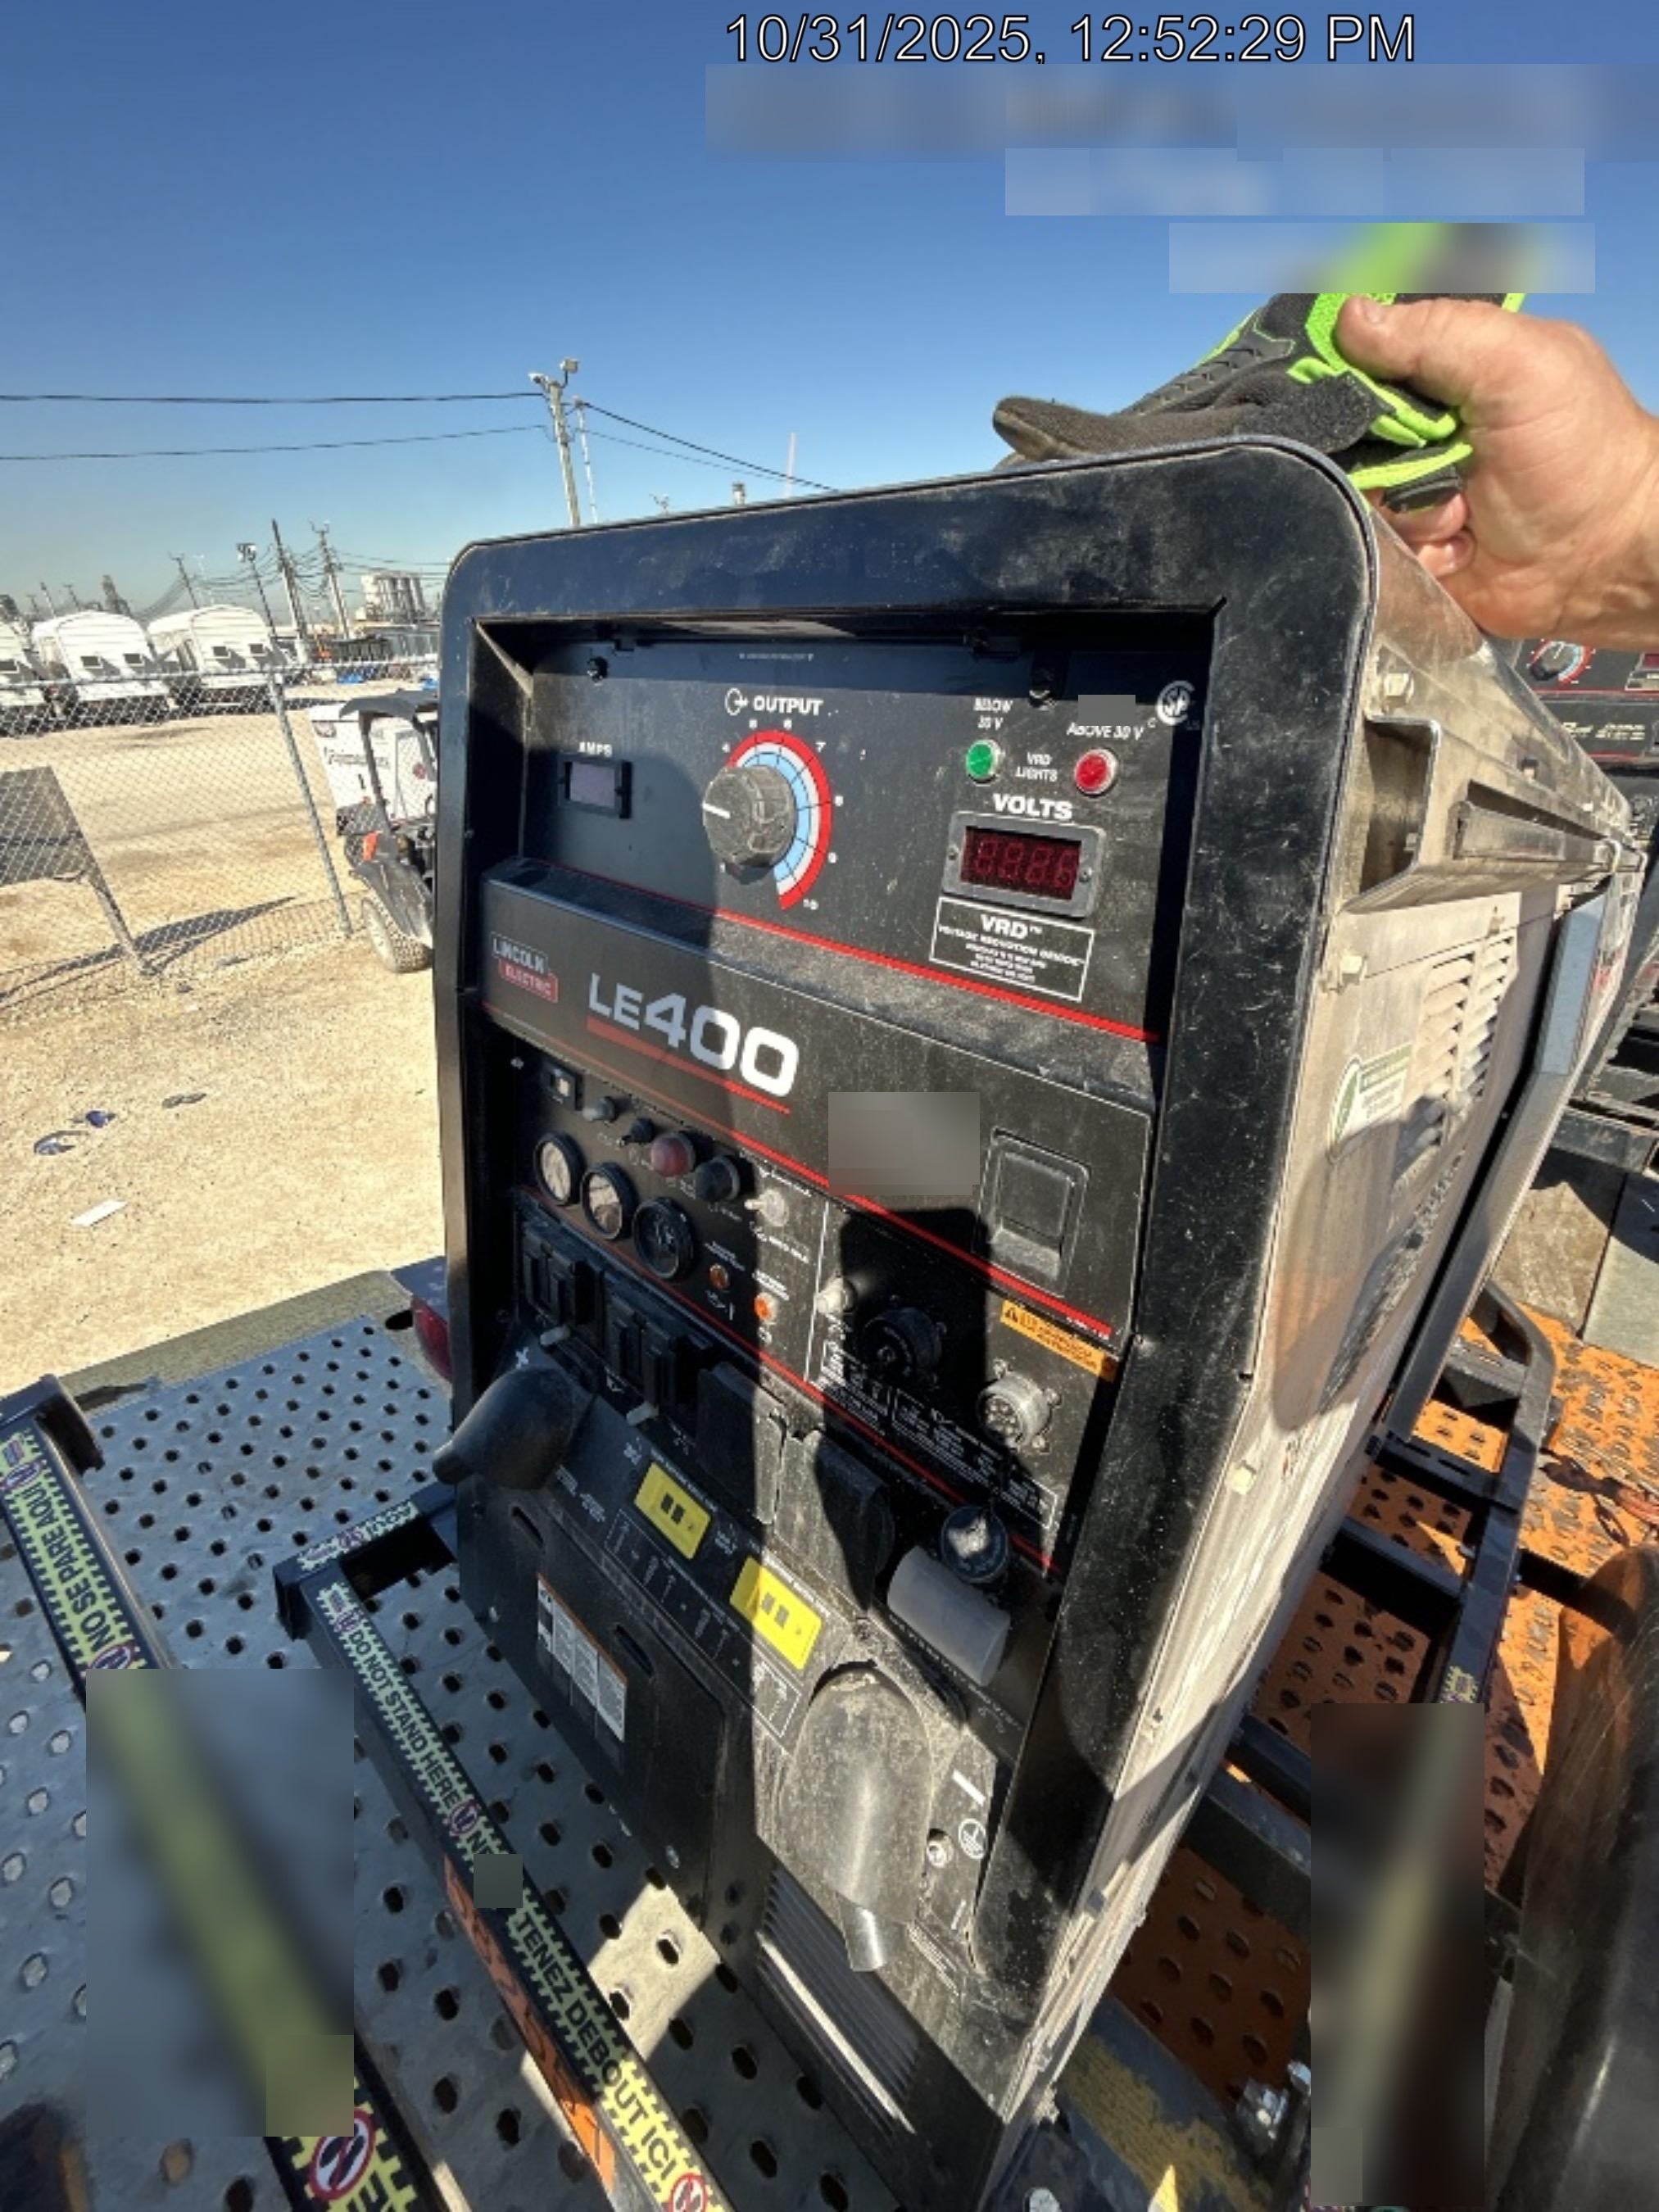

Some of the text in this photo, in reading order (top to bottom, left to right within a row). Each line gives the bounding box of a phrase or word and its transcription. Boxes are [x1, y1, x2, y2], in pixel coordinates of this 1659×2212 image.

[753, 696, 823, 716] OUTPUT
[578, 741, 612, 755] AMPS
[1067, 722, 1112, 737] ABOVE
[1015, 766, 1058, 782] LIGHTS
[993, 794, 1072, 820] VOLTS
[492, 936, 545, 974] LINCOLN
[505, 963, 552, 997] ELECTRIC
[588, 972, 800, 1097] LE400
[41, 1524, 84, 1584] PARE
[66, 1576, 97, 1615] SE
[80, 1610, 116, 1652] NO
[349, 1630, 462, 1808] DO NOT STAND HERE
[517, 1912, 574, 2005] TENEZ
[565, 1998, 649, 2126] DEBOUT
[640, 2126, 677, 2181] ICI
